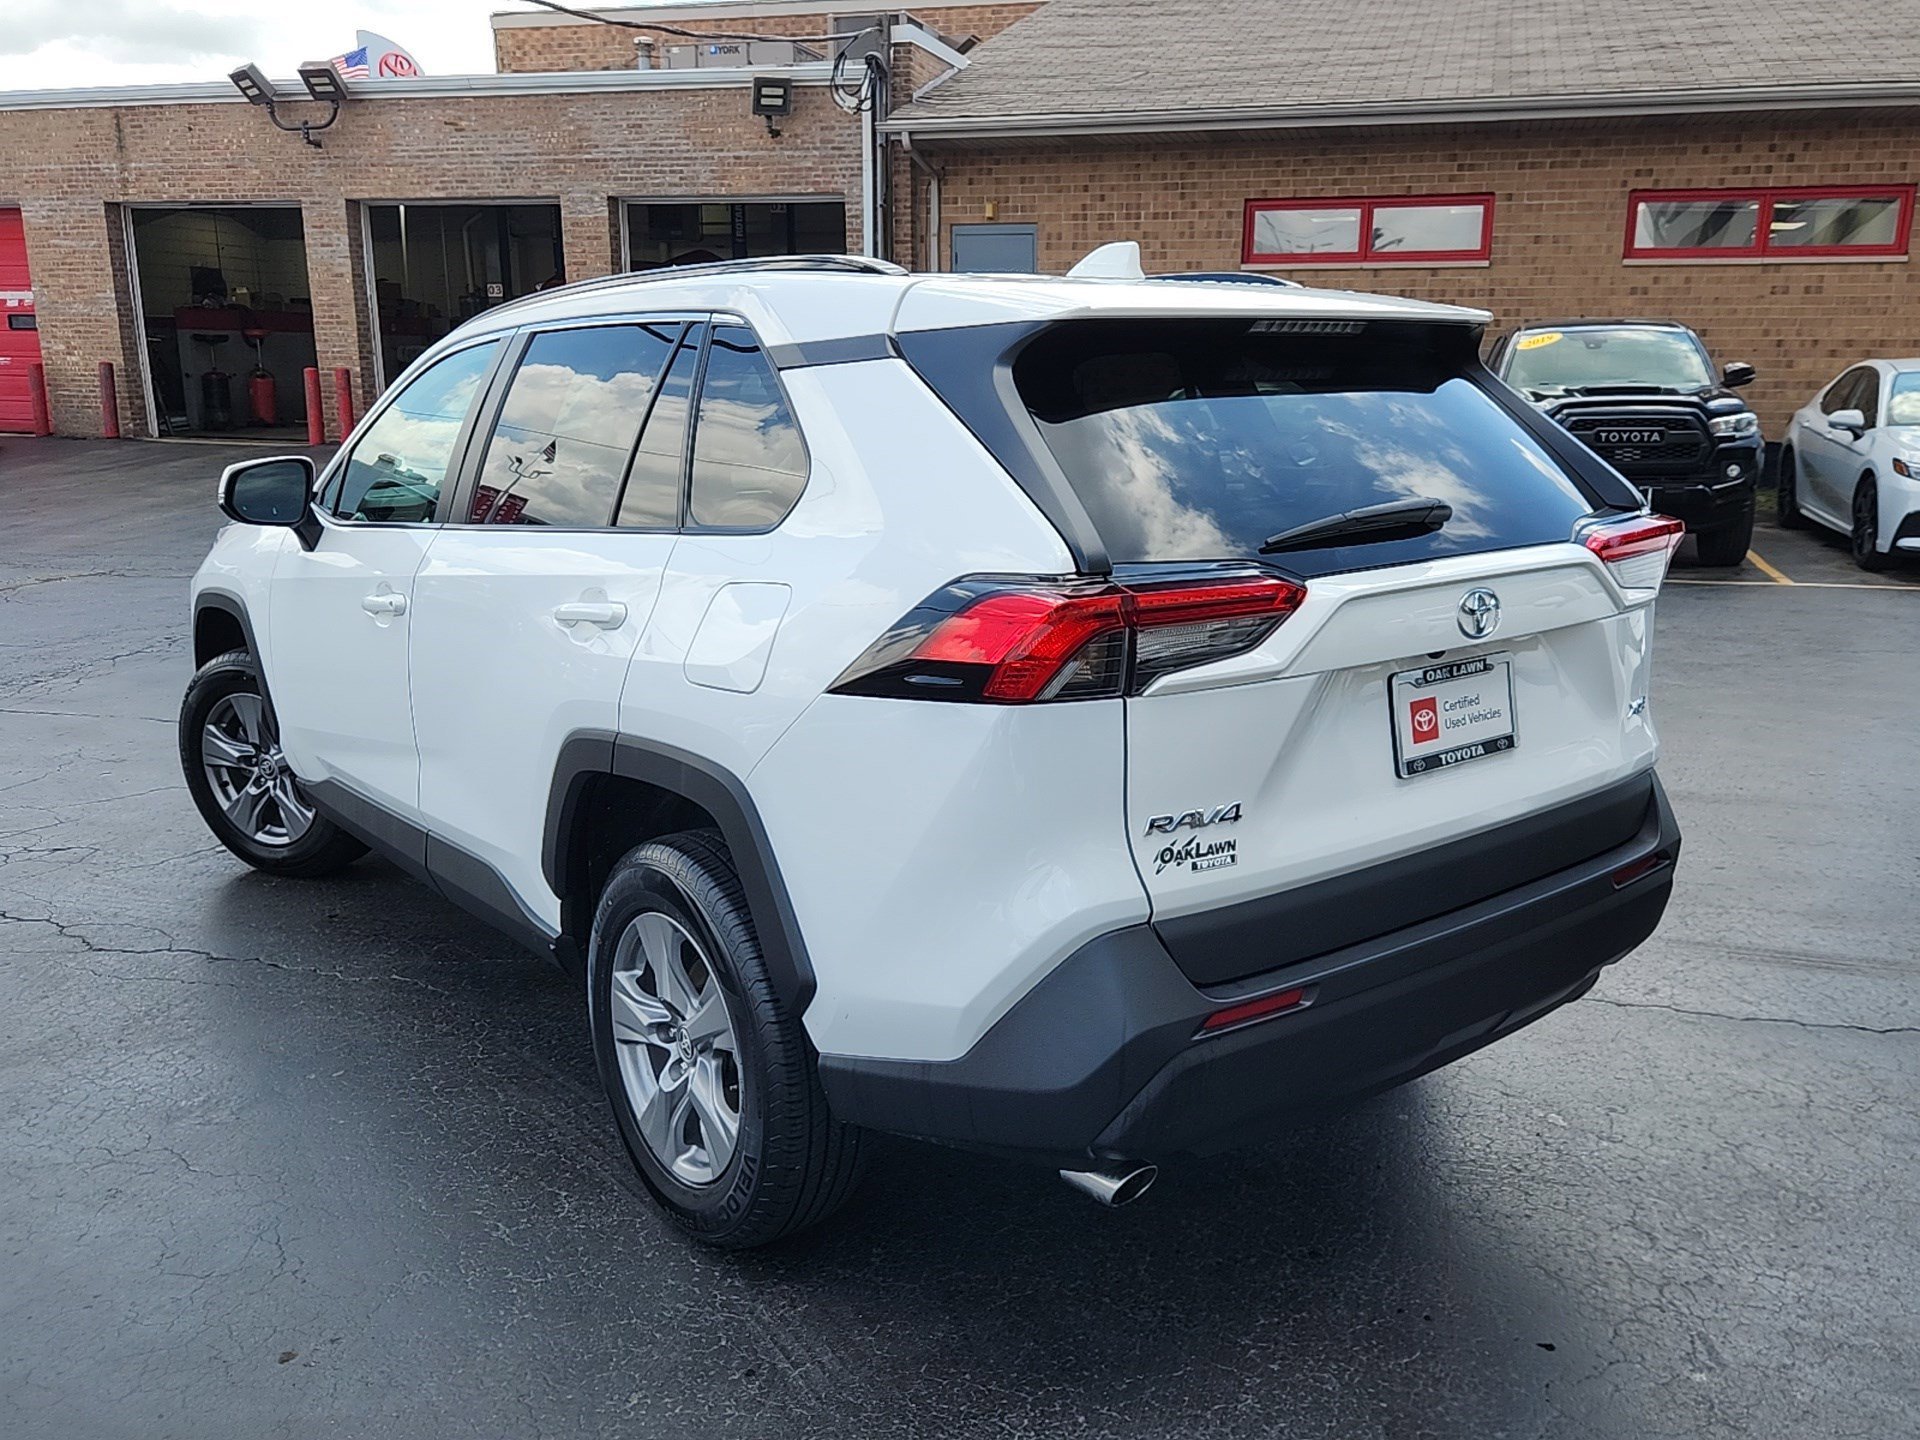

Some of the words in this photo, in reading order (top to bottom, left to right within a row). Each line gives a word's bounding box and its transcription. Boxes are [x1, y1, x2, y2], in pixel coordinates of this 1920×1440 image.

[719, 45, 740, 54] YORK
[1600, 431, 1660, 442] TOYOTA
[1426, 666, 1451, 681] OAK
[1452, 660, 1485, 677] LAWN
[1443, 694, 1480, 712] Certified
[1444, 715, 1467, 730] Used
[1468, 708, 1502, 724] Vehicles
[1439, 744, 1485, 765] TOYOTA
[1144, 800, 1242, 838] RAV4
[1196, 857, 1232, 871] TOYOTA
